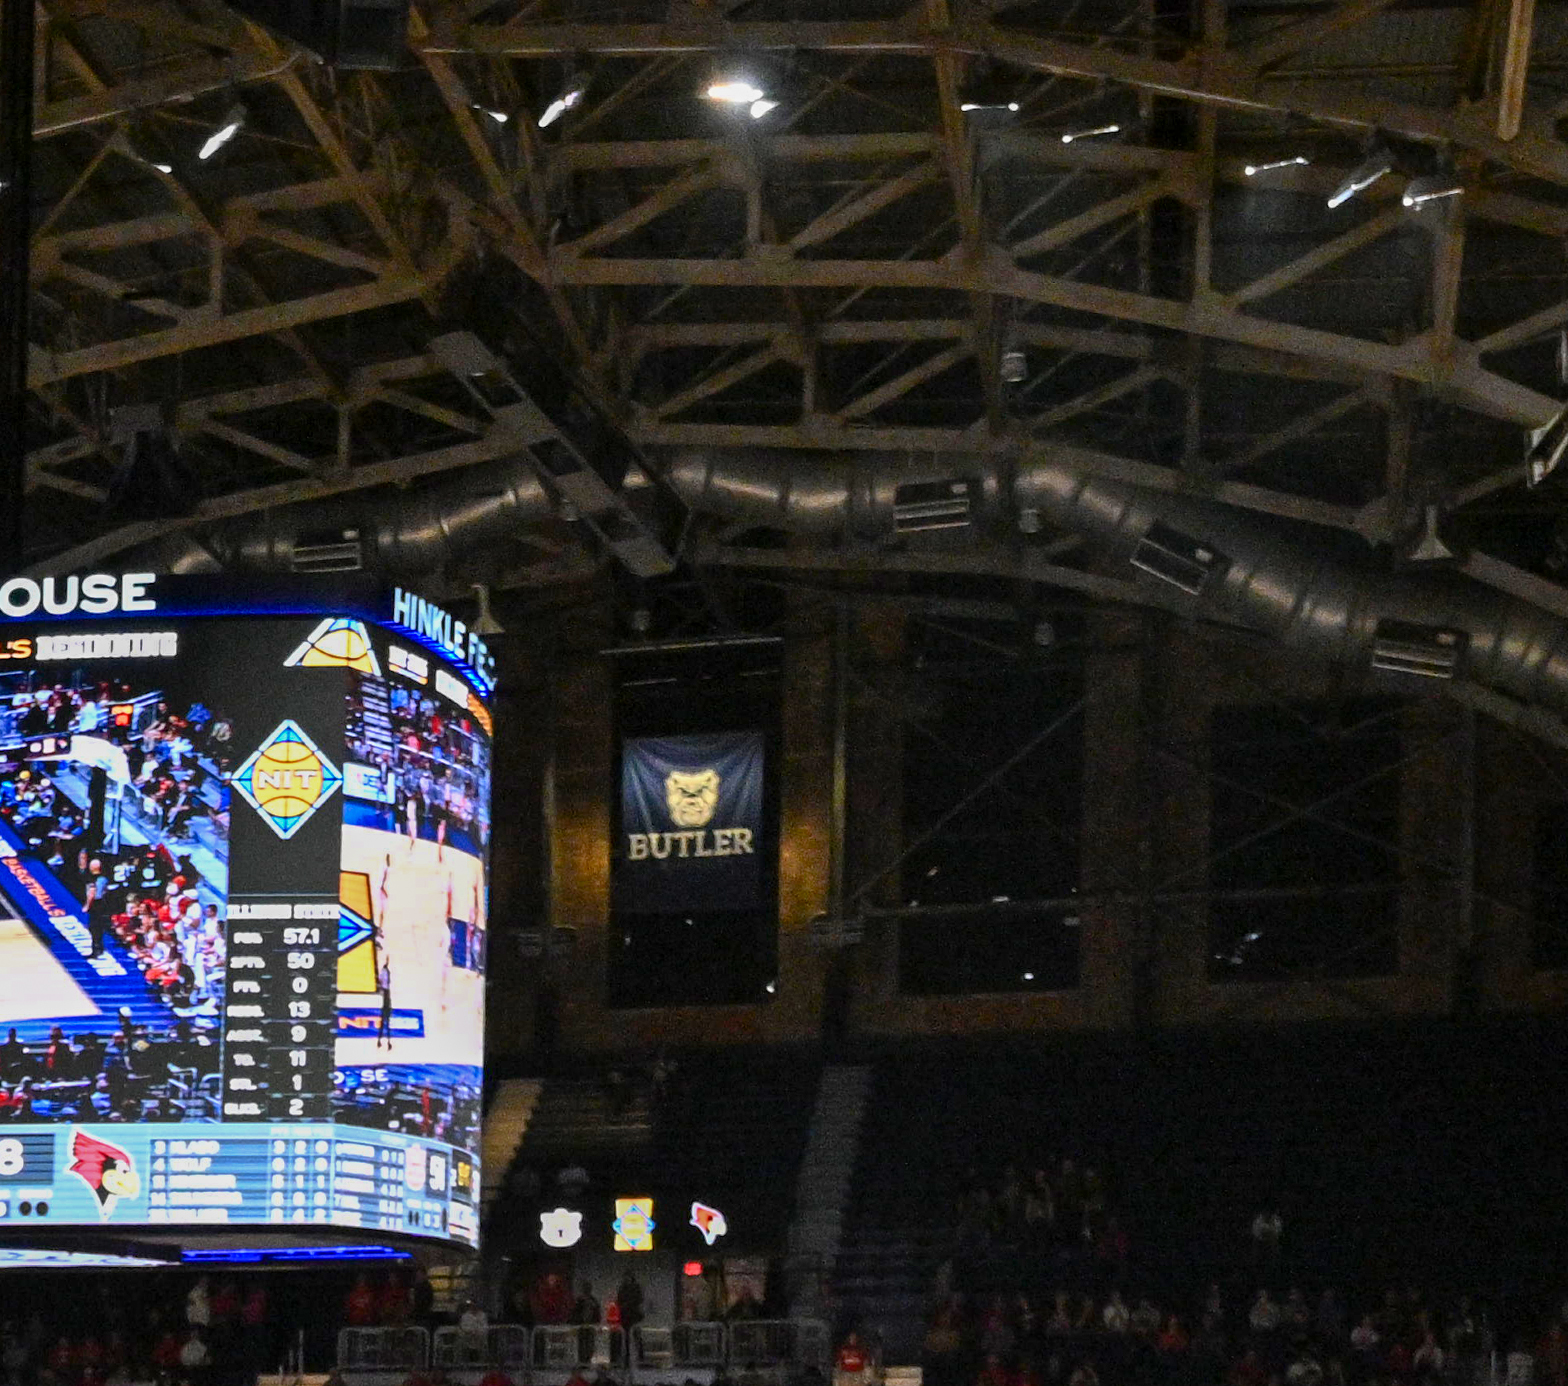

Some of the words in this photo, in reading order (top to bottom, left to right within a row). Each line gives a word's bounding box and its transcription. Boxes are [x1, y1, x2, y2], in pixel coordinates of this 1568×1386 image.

[394, 587, 466, 660] HINKLE
[258, 770, 318, 789] NIT
[628, 828, 753, 860] BUTLER
[283, 927, 320, 944] 57.1
[287, 952, 315, 969] 50
[288, 1001, 310, 1017] 13
[292, 1074, 302, 1091] 1
[289, 1098, 304, 1115] 2
